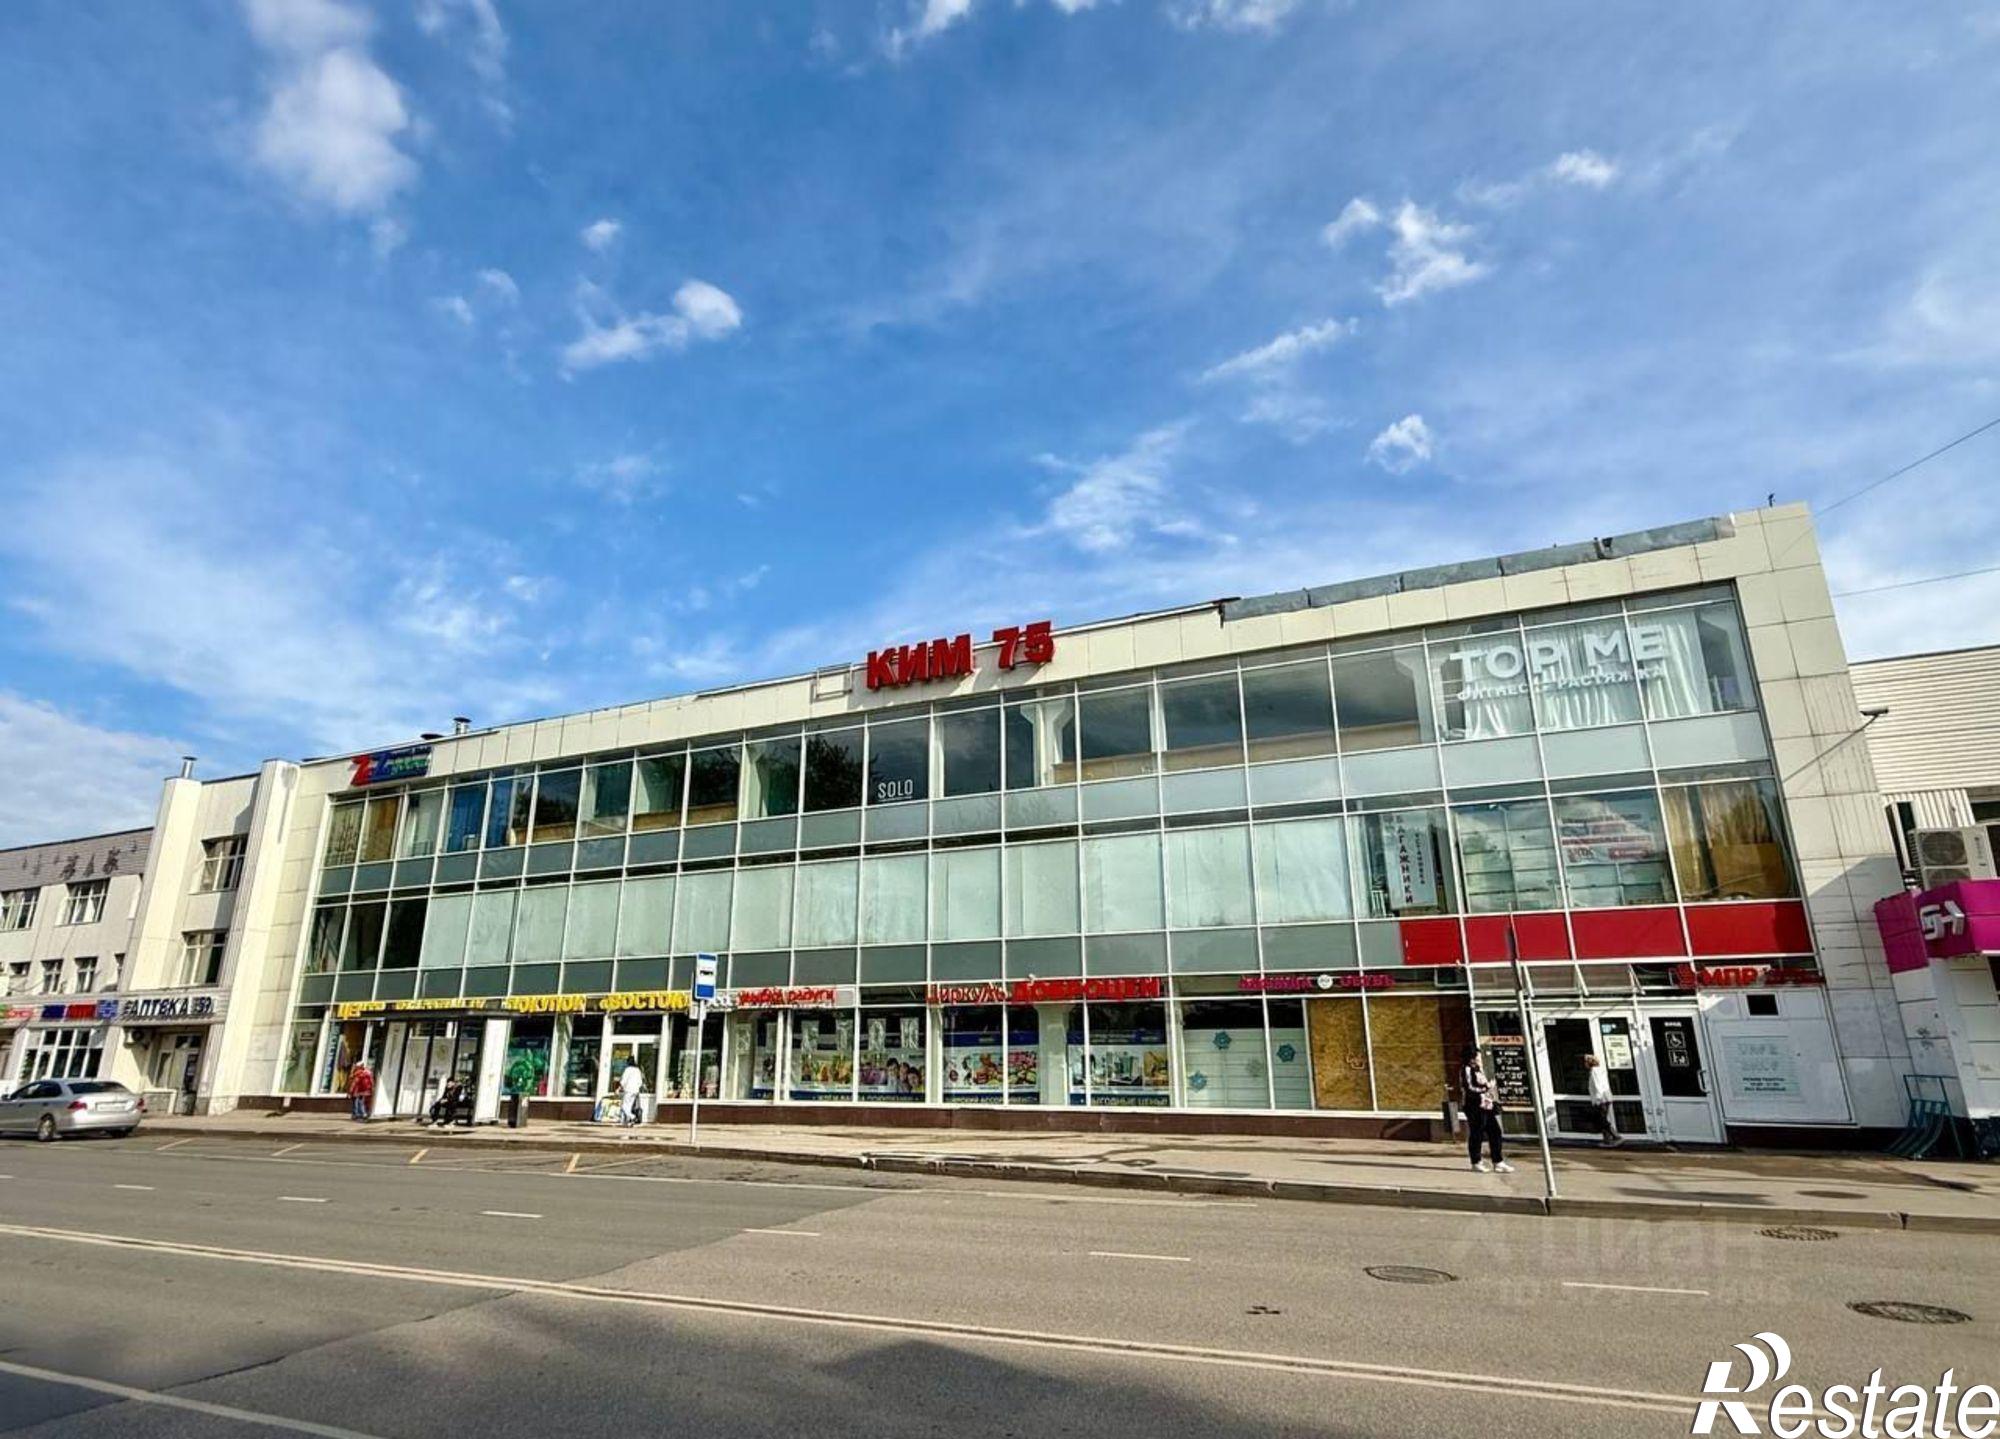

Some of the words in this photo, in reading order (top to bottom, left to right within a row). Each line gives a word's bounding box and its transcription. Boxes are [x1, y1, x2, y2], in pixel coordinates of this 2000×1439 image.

[867, 633, 973, 690] КИМ
[993, 621, 1054, 671] 75
[1450, 640, 1563, 683] TOP
[1583, 624, 1667, 667] ME
[877, 779, 914, 800] SOLO
[129, 997, 189, 1016] АПТЕКА
